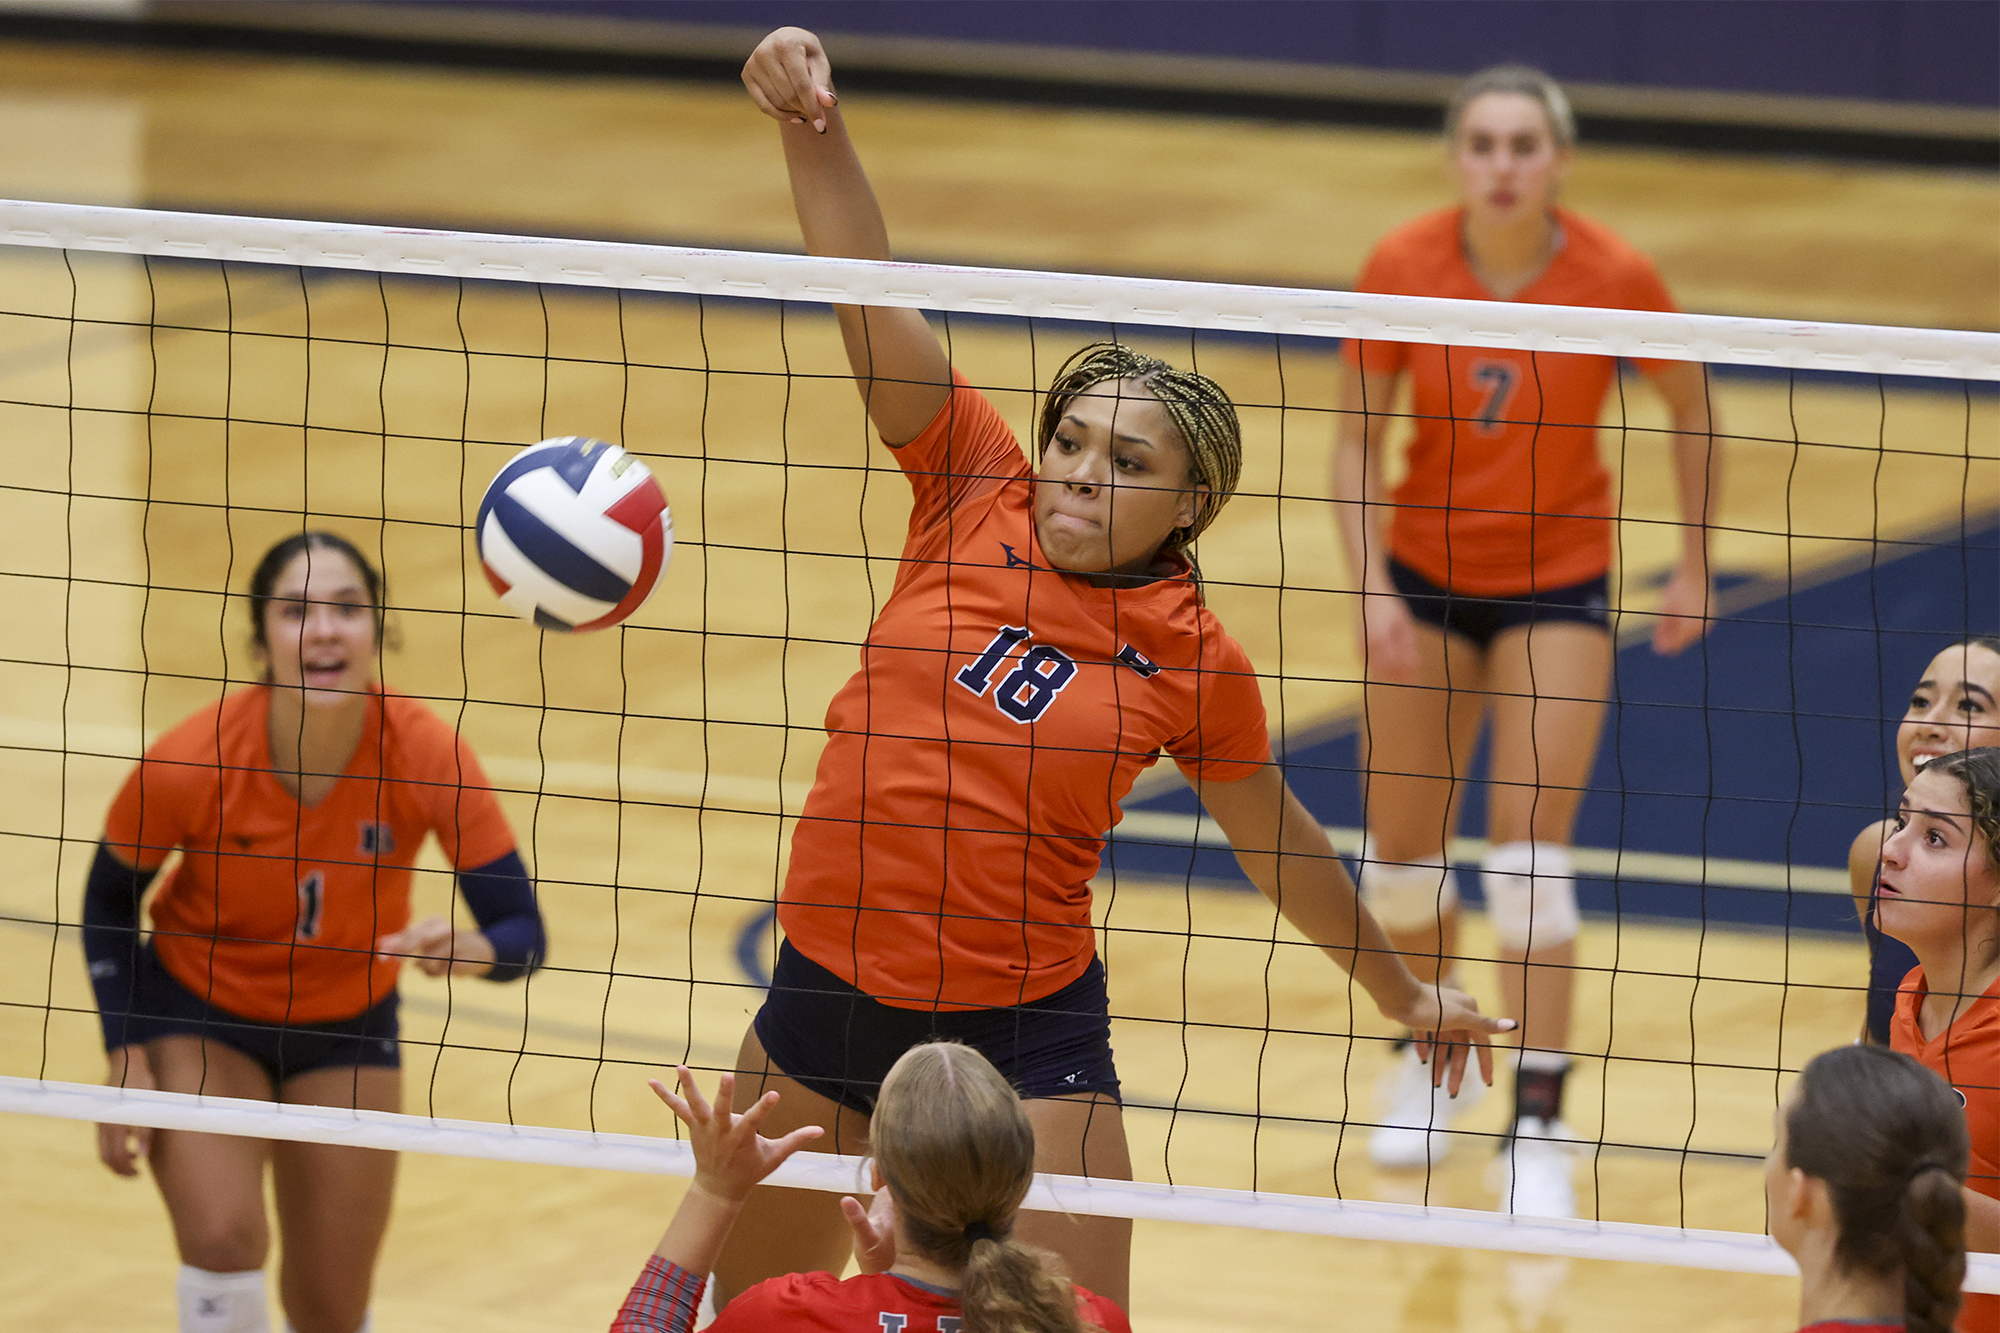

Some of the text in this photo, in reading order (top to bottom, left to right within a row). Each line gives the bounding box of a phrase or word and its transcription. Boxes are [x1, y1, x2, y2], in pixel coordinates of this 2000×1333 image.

[1468, 358, 1521, 438] 7
[953, 624, 1079, 725] 18
[297, 869, 325, 941] 1
